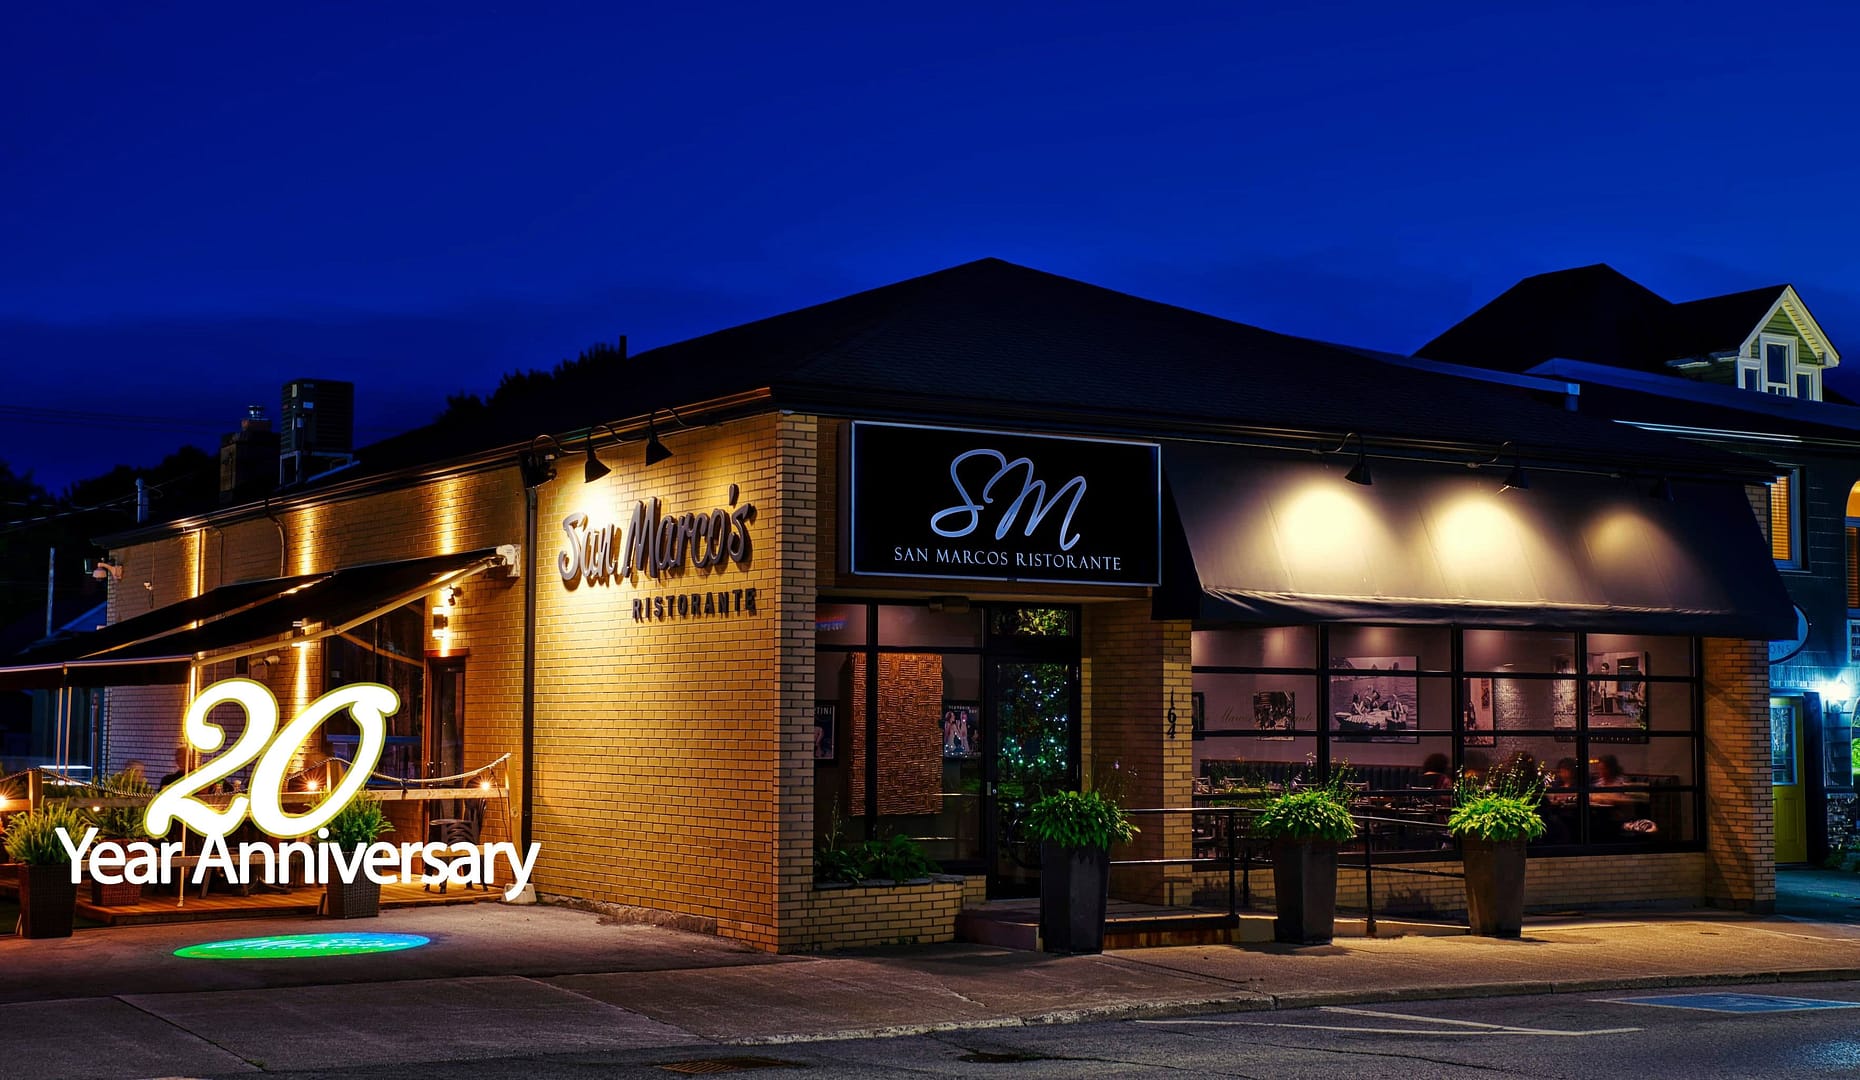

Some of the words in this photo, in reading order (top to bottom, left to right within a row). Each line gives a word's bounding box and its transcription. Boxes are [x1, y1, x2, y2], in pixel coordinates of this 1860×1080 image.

[558, 512, 616, 580] San
[622, 483, 752, 578] Marco's
[894, 547, 928, 562] SAN
[936, 548, 1008, 565] MARCOS
[1016, 552, 1121, 571] RISTORANTE
[633, 588, 757, 620] RISTORANTE
[1166, 687, 1177, 738] 164
